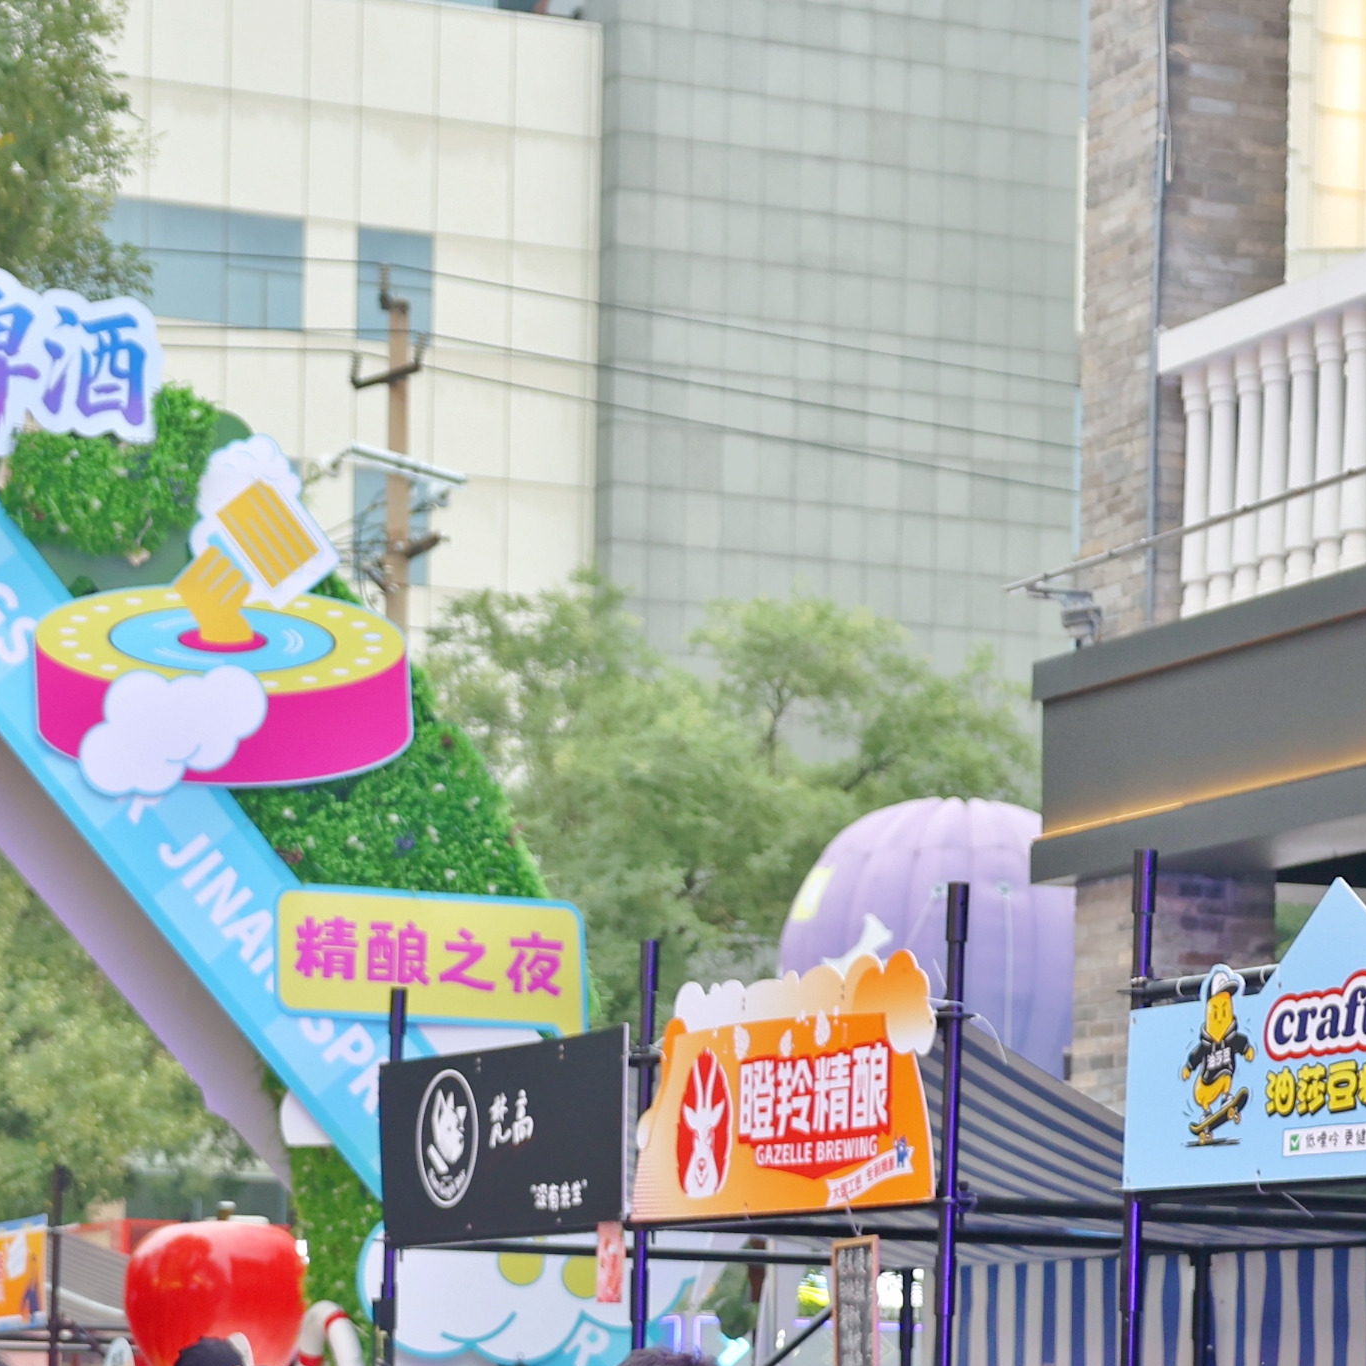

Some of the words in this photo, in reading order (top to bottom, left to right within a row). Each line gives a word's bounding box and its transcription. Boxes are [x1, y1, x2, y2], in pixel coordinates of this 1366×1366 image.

[158, 834, 276, 992] JINA
[295, 916, 564, 997] 精酿之夜
[739, 1042, 889, 1140] 瞪羚精酿
[755, 1143, 813, 1165] GAZELLE
[815, 1135, 878, 1162] BREWING
